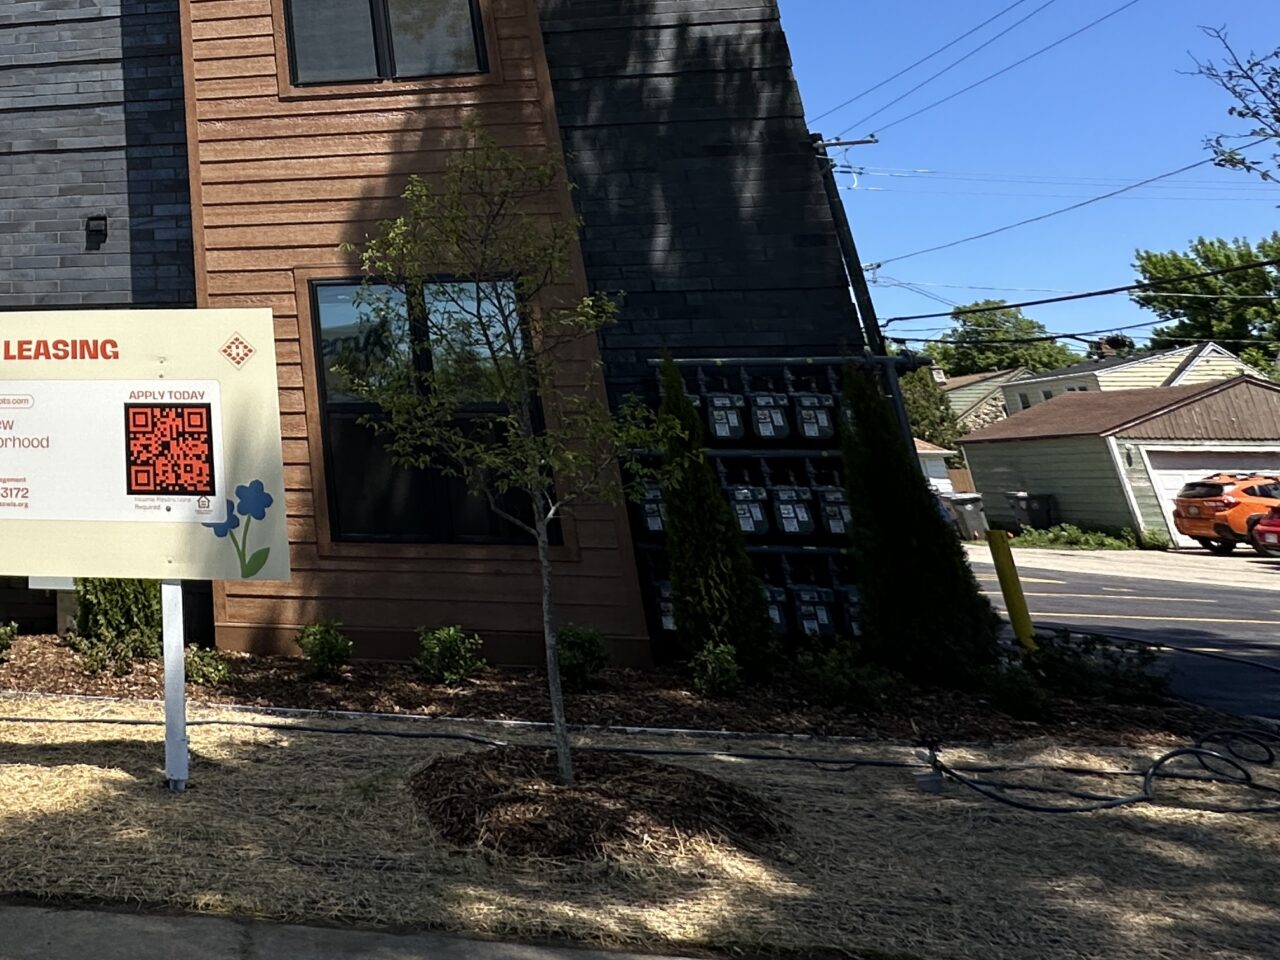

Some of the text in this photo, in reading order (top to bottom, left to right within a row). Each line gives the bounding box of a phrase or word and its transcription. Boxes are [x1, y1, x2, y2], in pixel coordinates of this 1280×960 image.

[3, 339, 120, 360] LEASING
[128, 390, 205, 400] APPLY TODAY
